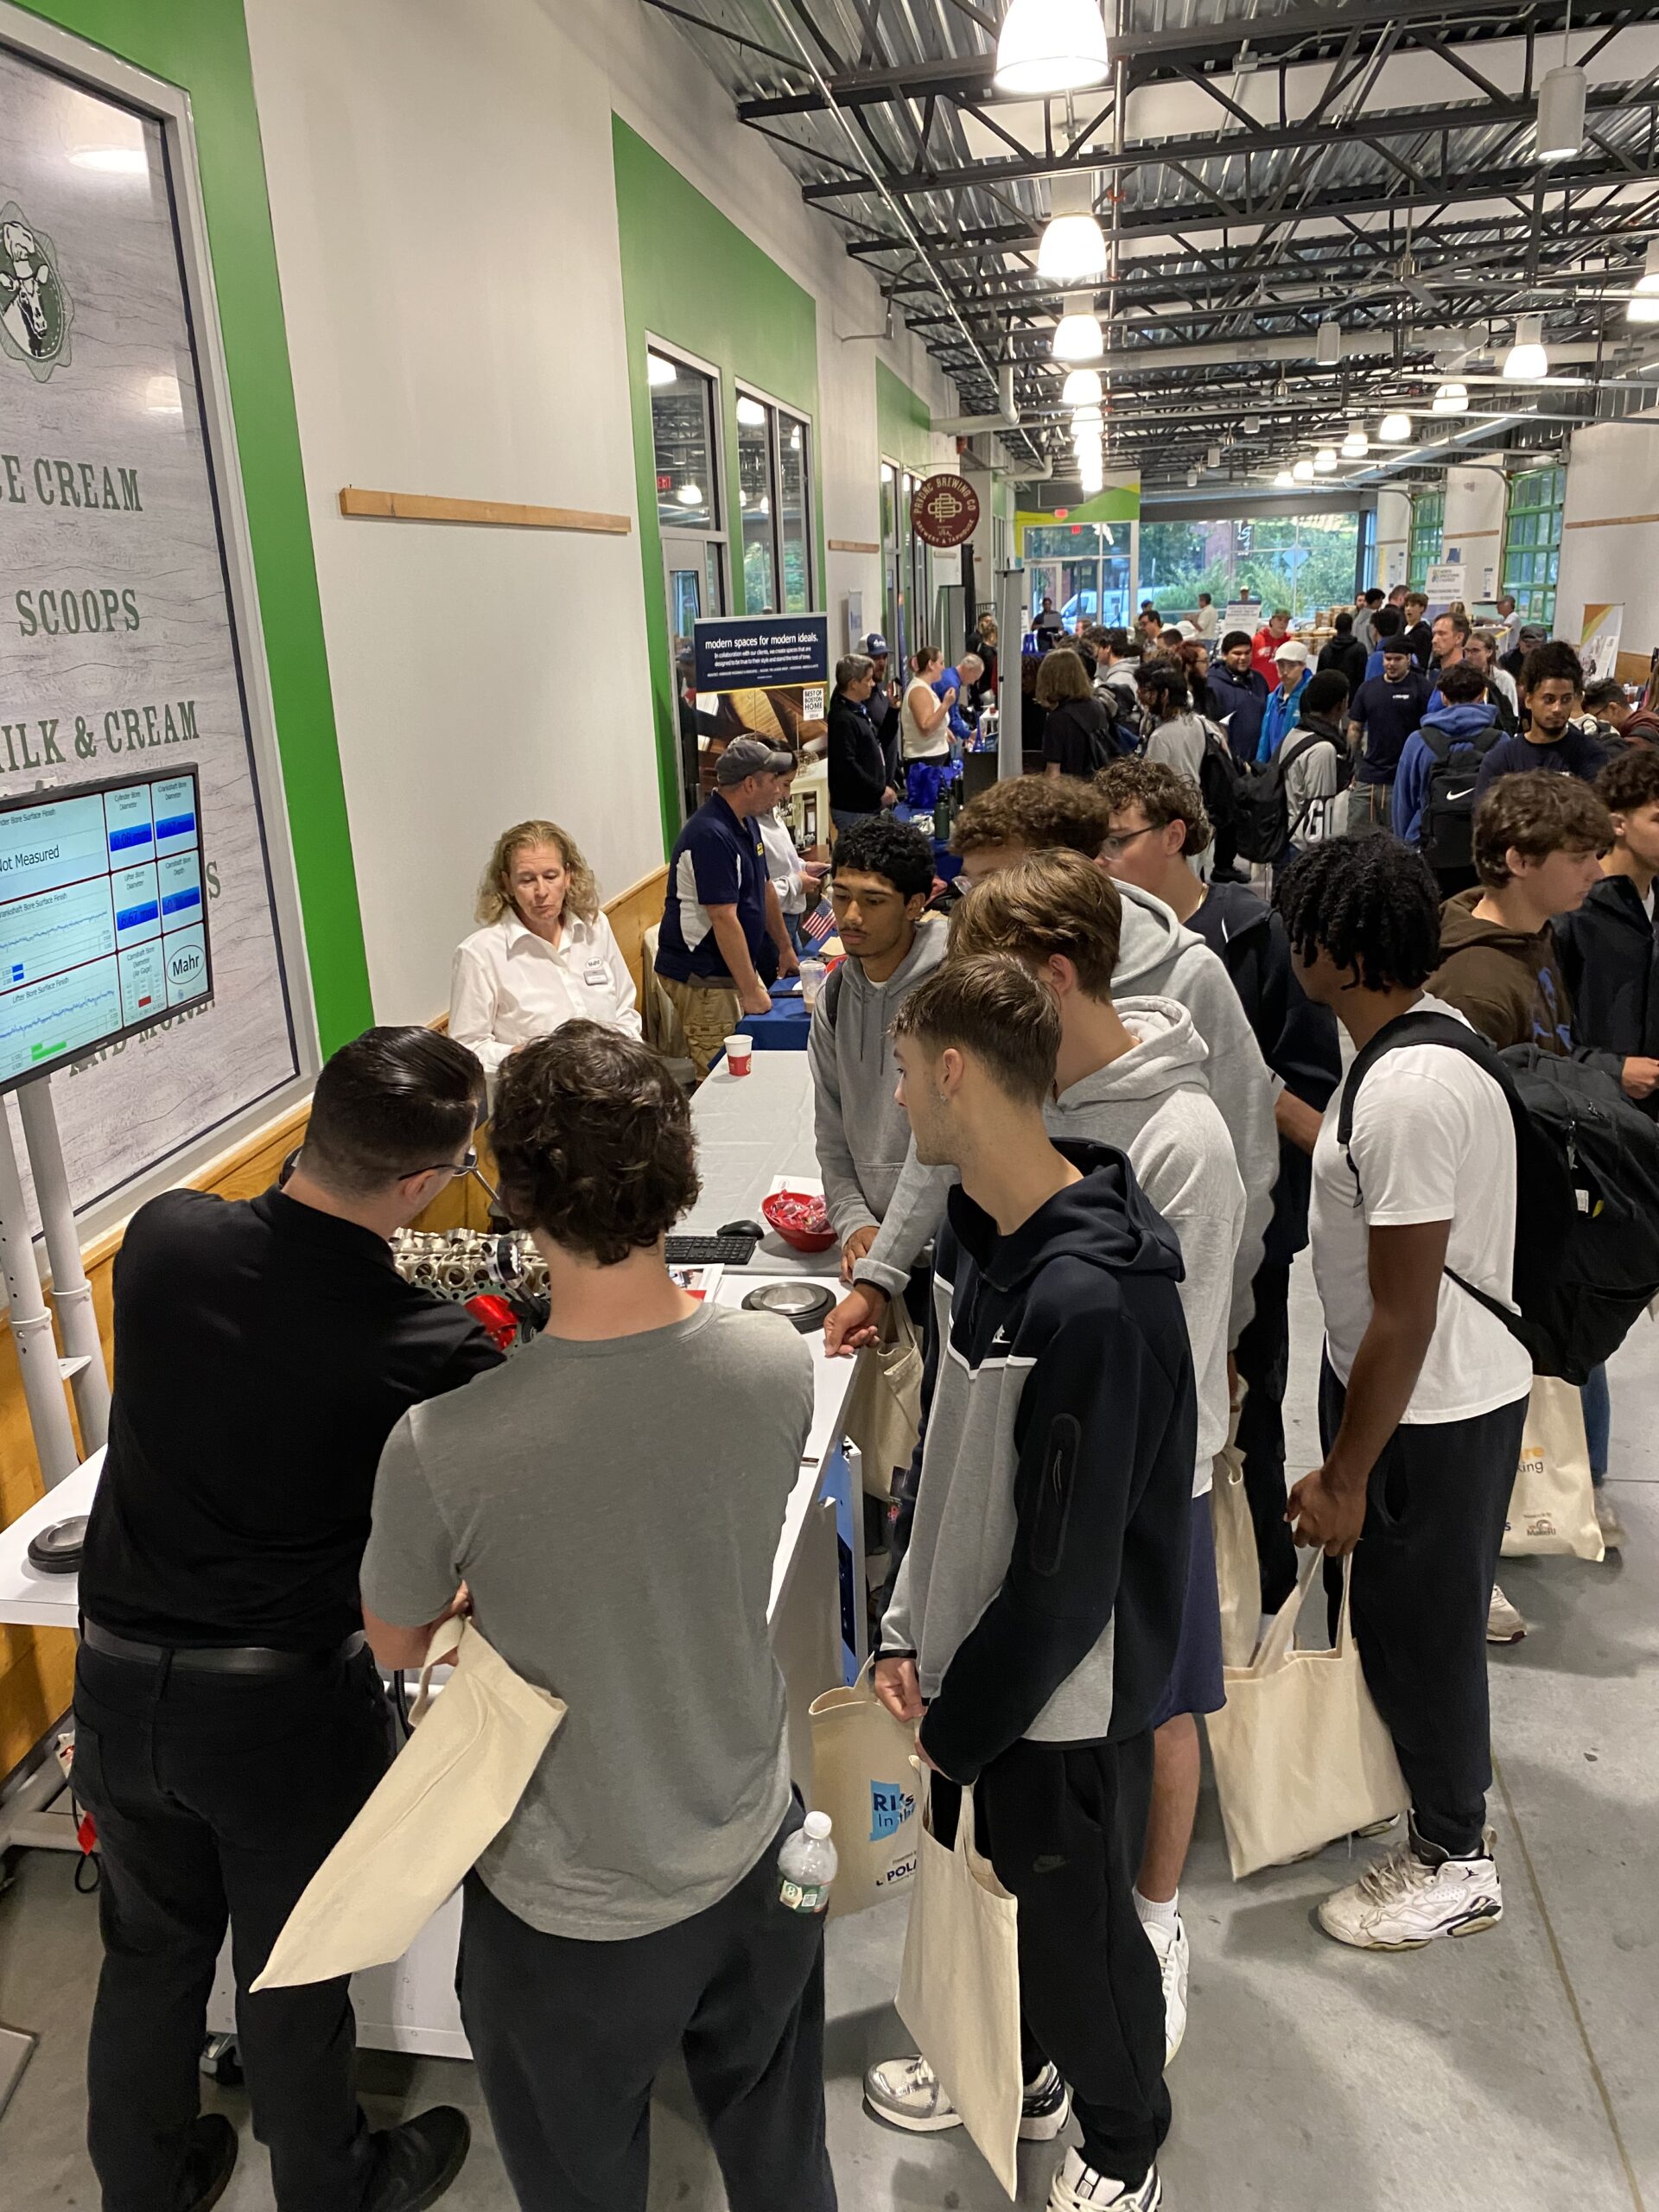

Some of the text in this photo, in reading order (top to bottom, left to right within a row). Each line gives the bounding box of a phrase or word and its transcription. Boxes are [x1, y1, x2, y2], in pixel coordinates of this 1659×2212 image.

[0, 454, 143, 512] E CREAM
[936, 476, 971, 498] BREWING
[966, 499, 976, 512] CO
[16, 588, 141, 637] SCOOPS
[705, 632, 819, 649] modern spaces for modern ideals.
[804, 702, 822, 710] HOME
[0, 701, 200, 773] ILK & CREAM
[114, 792, 131, 803] Cylinder
[165, 791, 181, 801] Diameter
[119, 801, 137, 811] Diameter
[11, 815, 22, 824] Bore
[23, 812, 41, 823] Surface
[42, 809, 56, 818] Finish
[16, 844, 60, 868] Measured
[135, 869, 145, 878] Bore
[174, 867, 185, 877] Depth
[126, 880, 144, 891] Diameter
[24, 902, 35, 911] Bore
[35, 896, 54, 907] Surface
[54, 893, 67, 904] Finish
[173, 954, 200, 977] Mahr
[12, 976, 70, 1005] Lifter Bore Surface Finish
[873, 1791, 915, 1812] RI's
[879, 1814, 894, 1827] In
